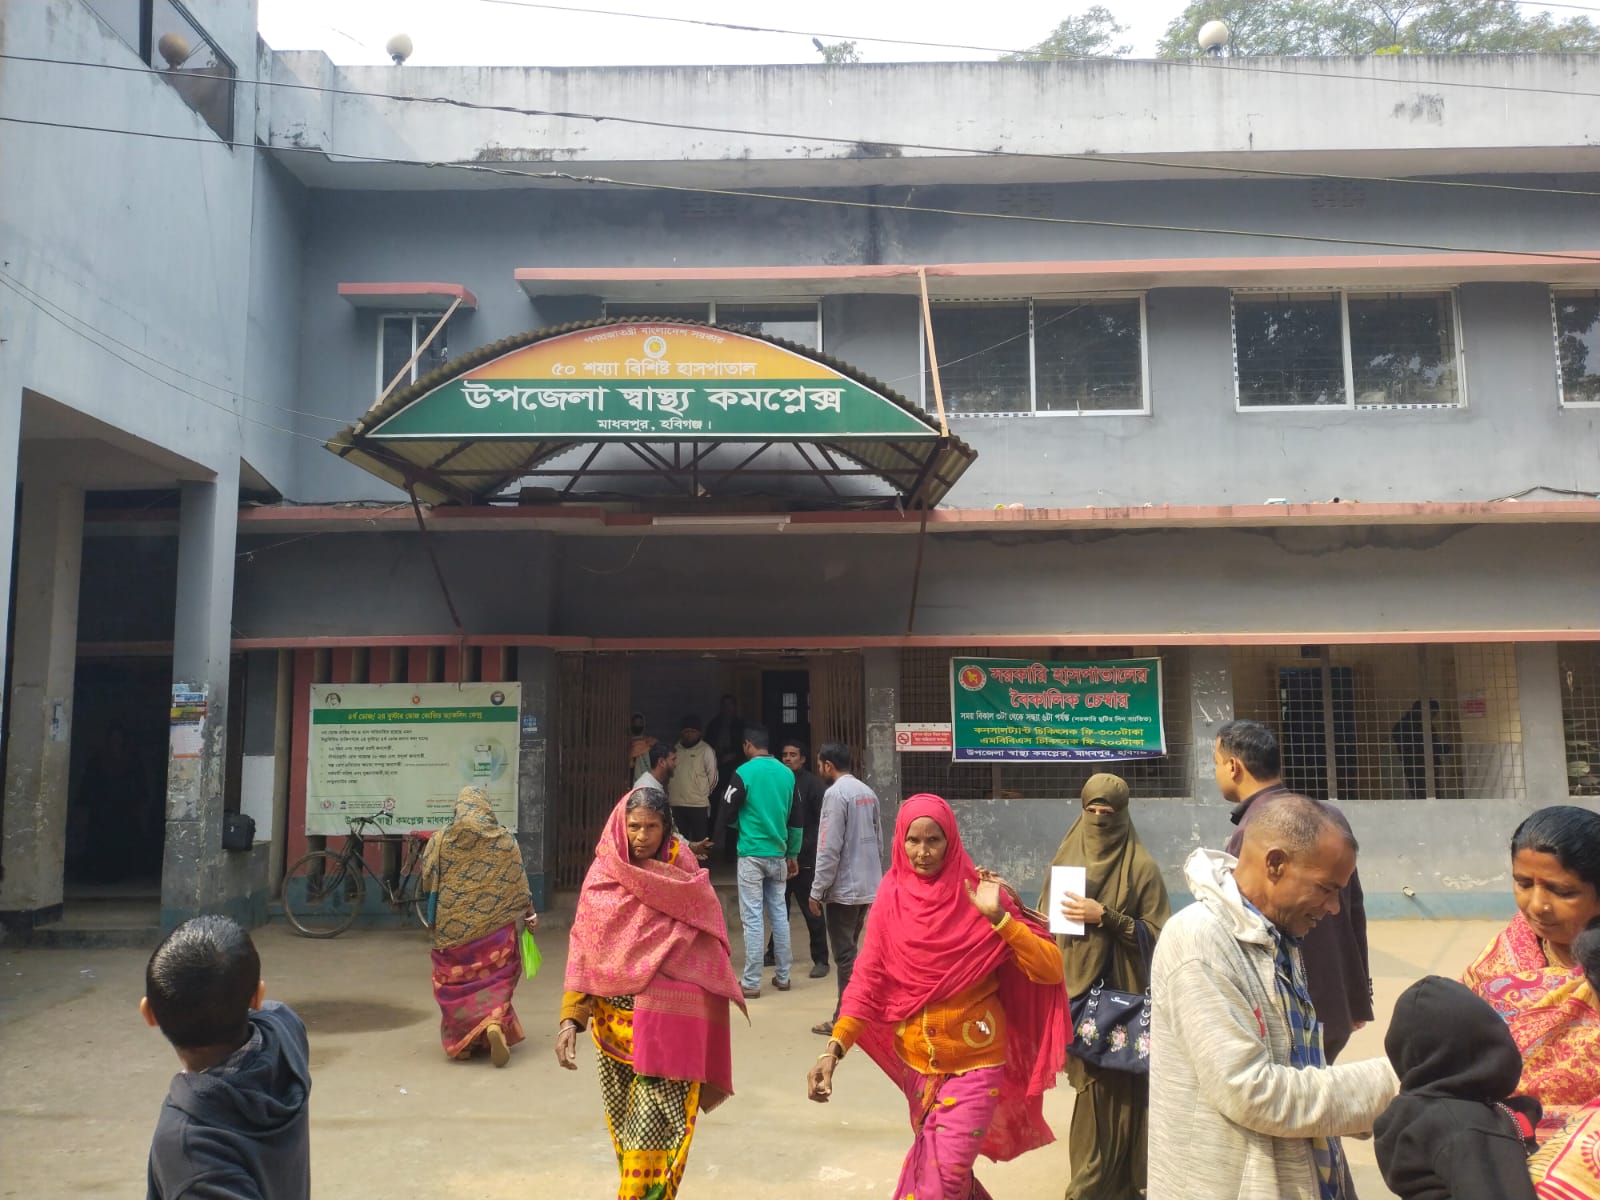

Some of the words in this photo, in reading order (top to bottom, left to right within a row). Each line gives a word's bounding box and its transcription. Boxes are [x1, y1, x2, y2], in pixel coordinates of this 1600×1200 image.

[640, 326, 689, 337] বাংলাদেশ
[691, 329, 726, 344] সরকার
[551, 362, 576, 376] ৫০
[583, 361, 620, 376] শয্যা
[625, 358, 671, 377] বিশিষ্ট
[675, 361, 758, 377] হাসপাতাল
[460, 380, 610, 413] উপজেলা
[616, 384, 696, 417] স্বাস্থ্য
[704, 384, 847, 414] কমপ্লেক্স
[989, 662, 1049, 684] সরকারি
[1051, 665, 1150, 687] হাসপাতালের
[1009, 687, 1080, 709] বৈকালিক
[1085, 690, 1131, 709] চেম্বার
[966, 748, 1005, 757] উপজেলা
